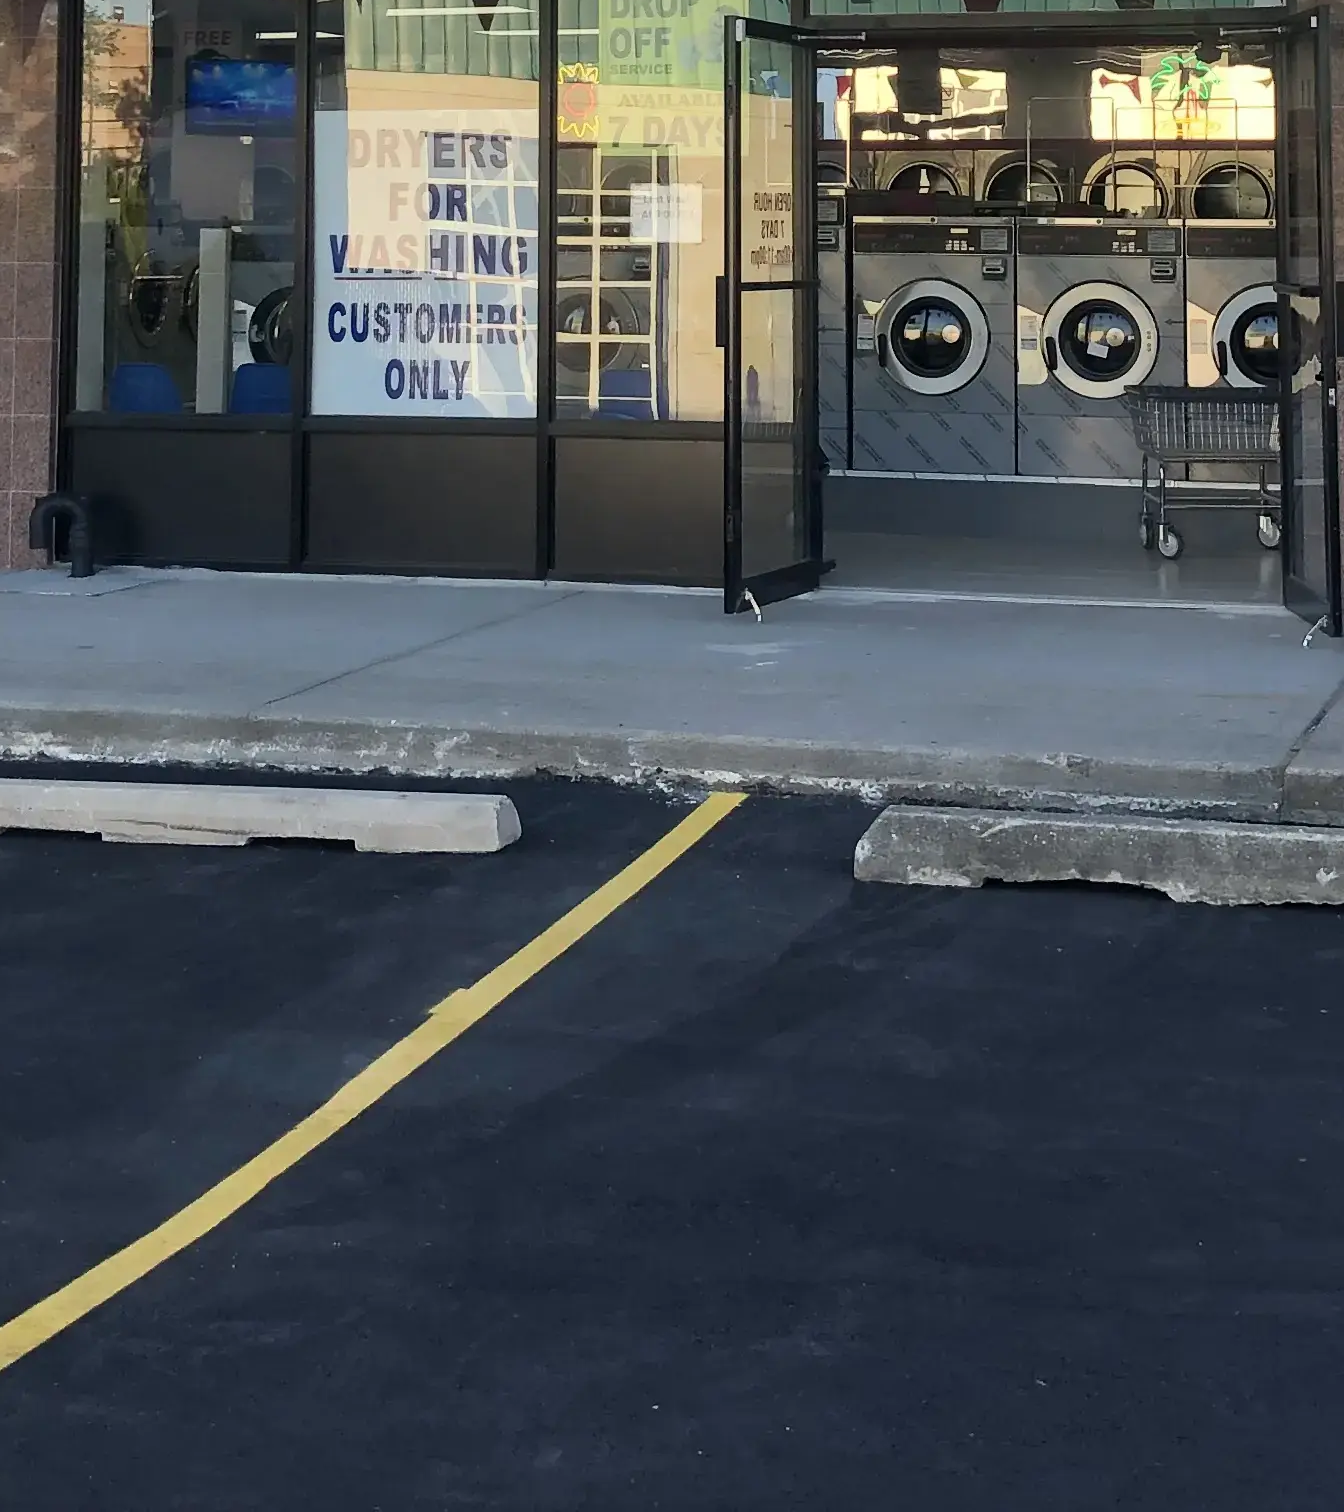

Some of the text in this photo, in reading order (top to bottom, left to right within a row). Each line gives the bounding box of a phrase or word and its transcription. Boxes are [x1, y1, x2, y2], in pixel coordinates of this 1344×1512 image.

[184, 30, 232, 46] FREE
[609, 27, 671, 58] OFF
[609, 64, 673, 75] SERVICE
[347, 129, 513, 169] DRYERS
[608, 117, 629, 148] 7
[389, 182, 468, 222] FOR
[329, 235, 529, 275] WASHING
[328, 302, 528, 345] CUSTOMERS
[384, 359, 471, 400] ONLY
